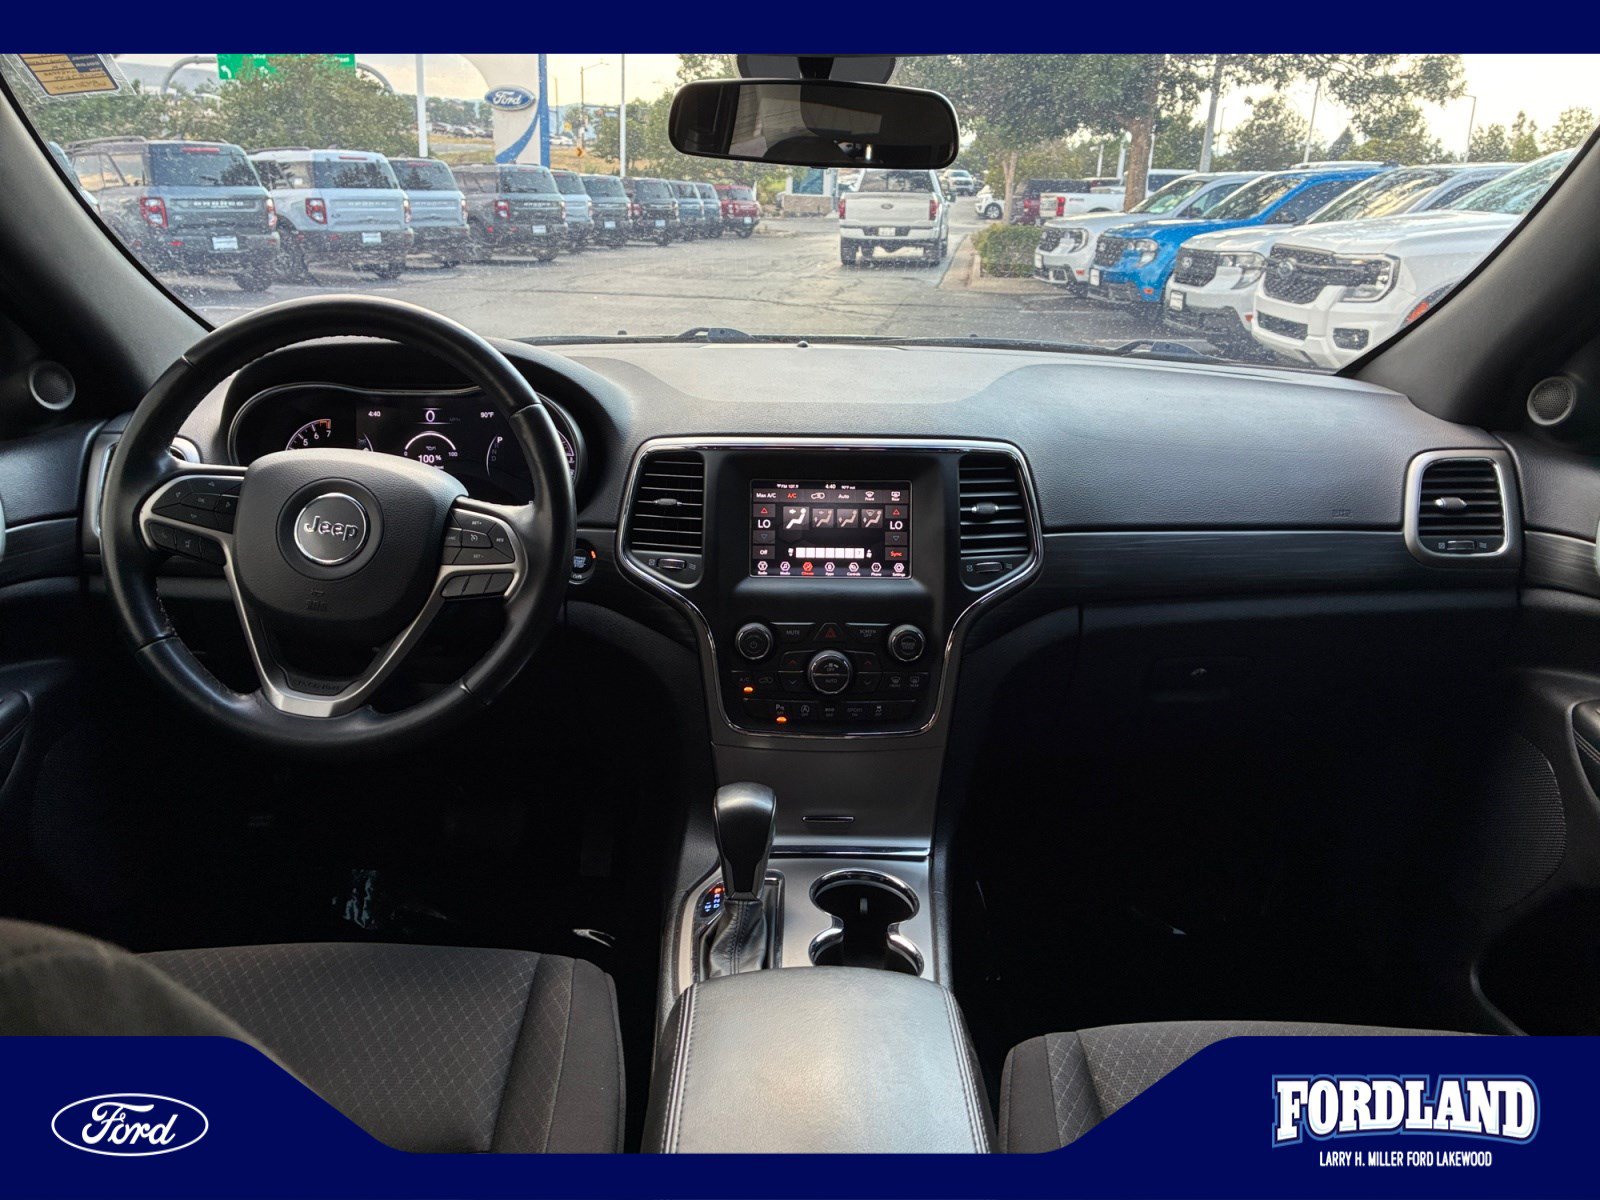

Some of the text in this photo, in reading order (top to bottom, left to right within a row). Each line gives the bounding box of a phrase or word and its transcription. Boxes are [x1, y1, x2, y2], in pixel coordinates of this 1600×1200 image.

[492, 88, 522, 106] Ford
[425, 410, 435, 422] 0
[303, 438, 308, 446] 5
[303, 515, 358, 541] Jeep
[757, 519, 771, 528] LO
[889, 520, 903, 530] LO
